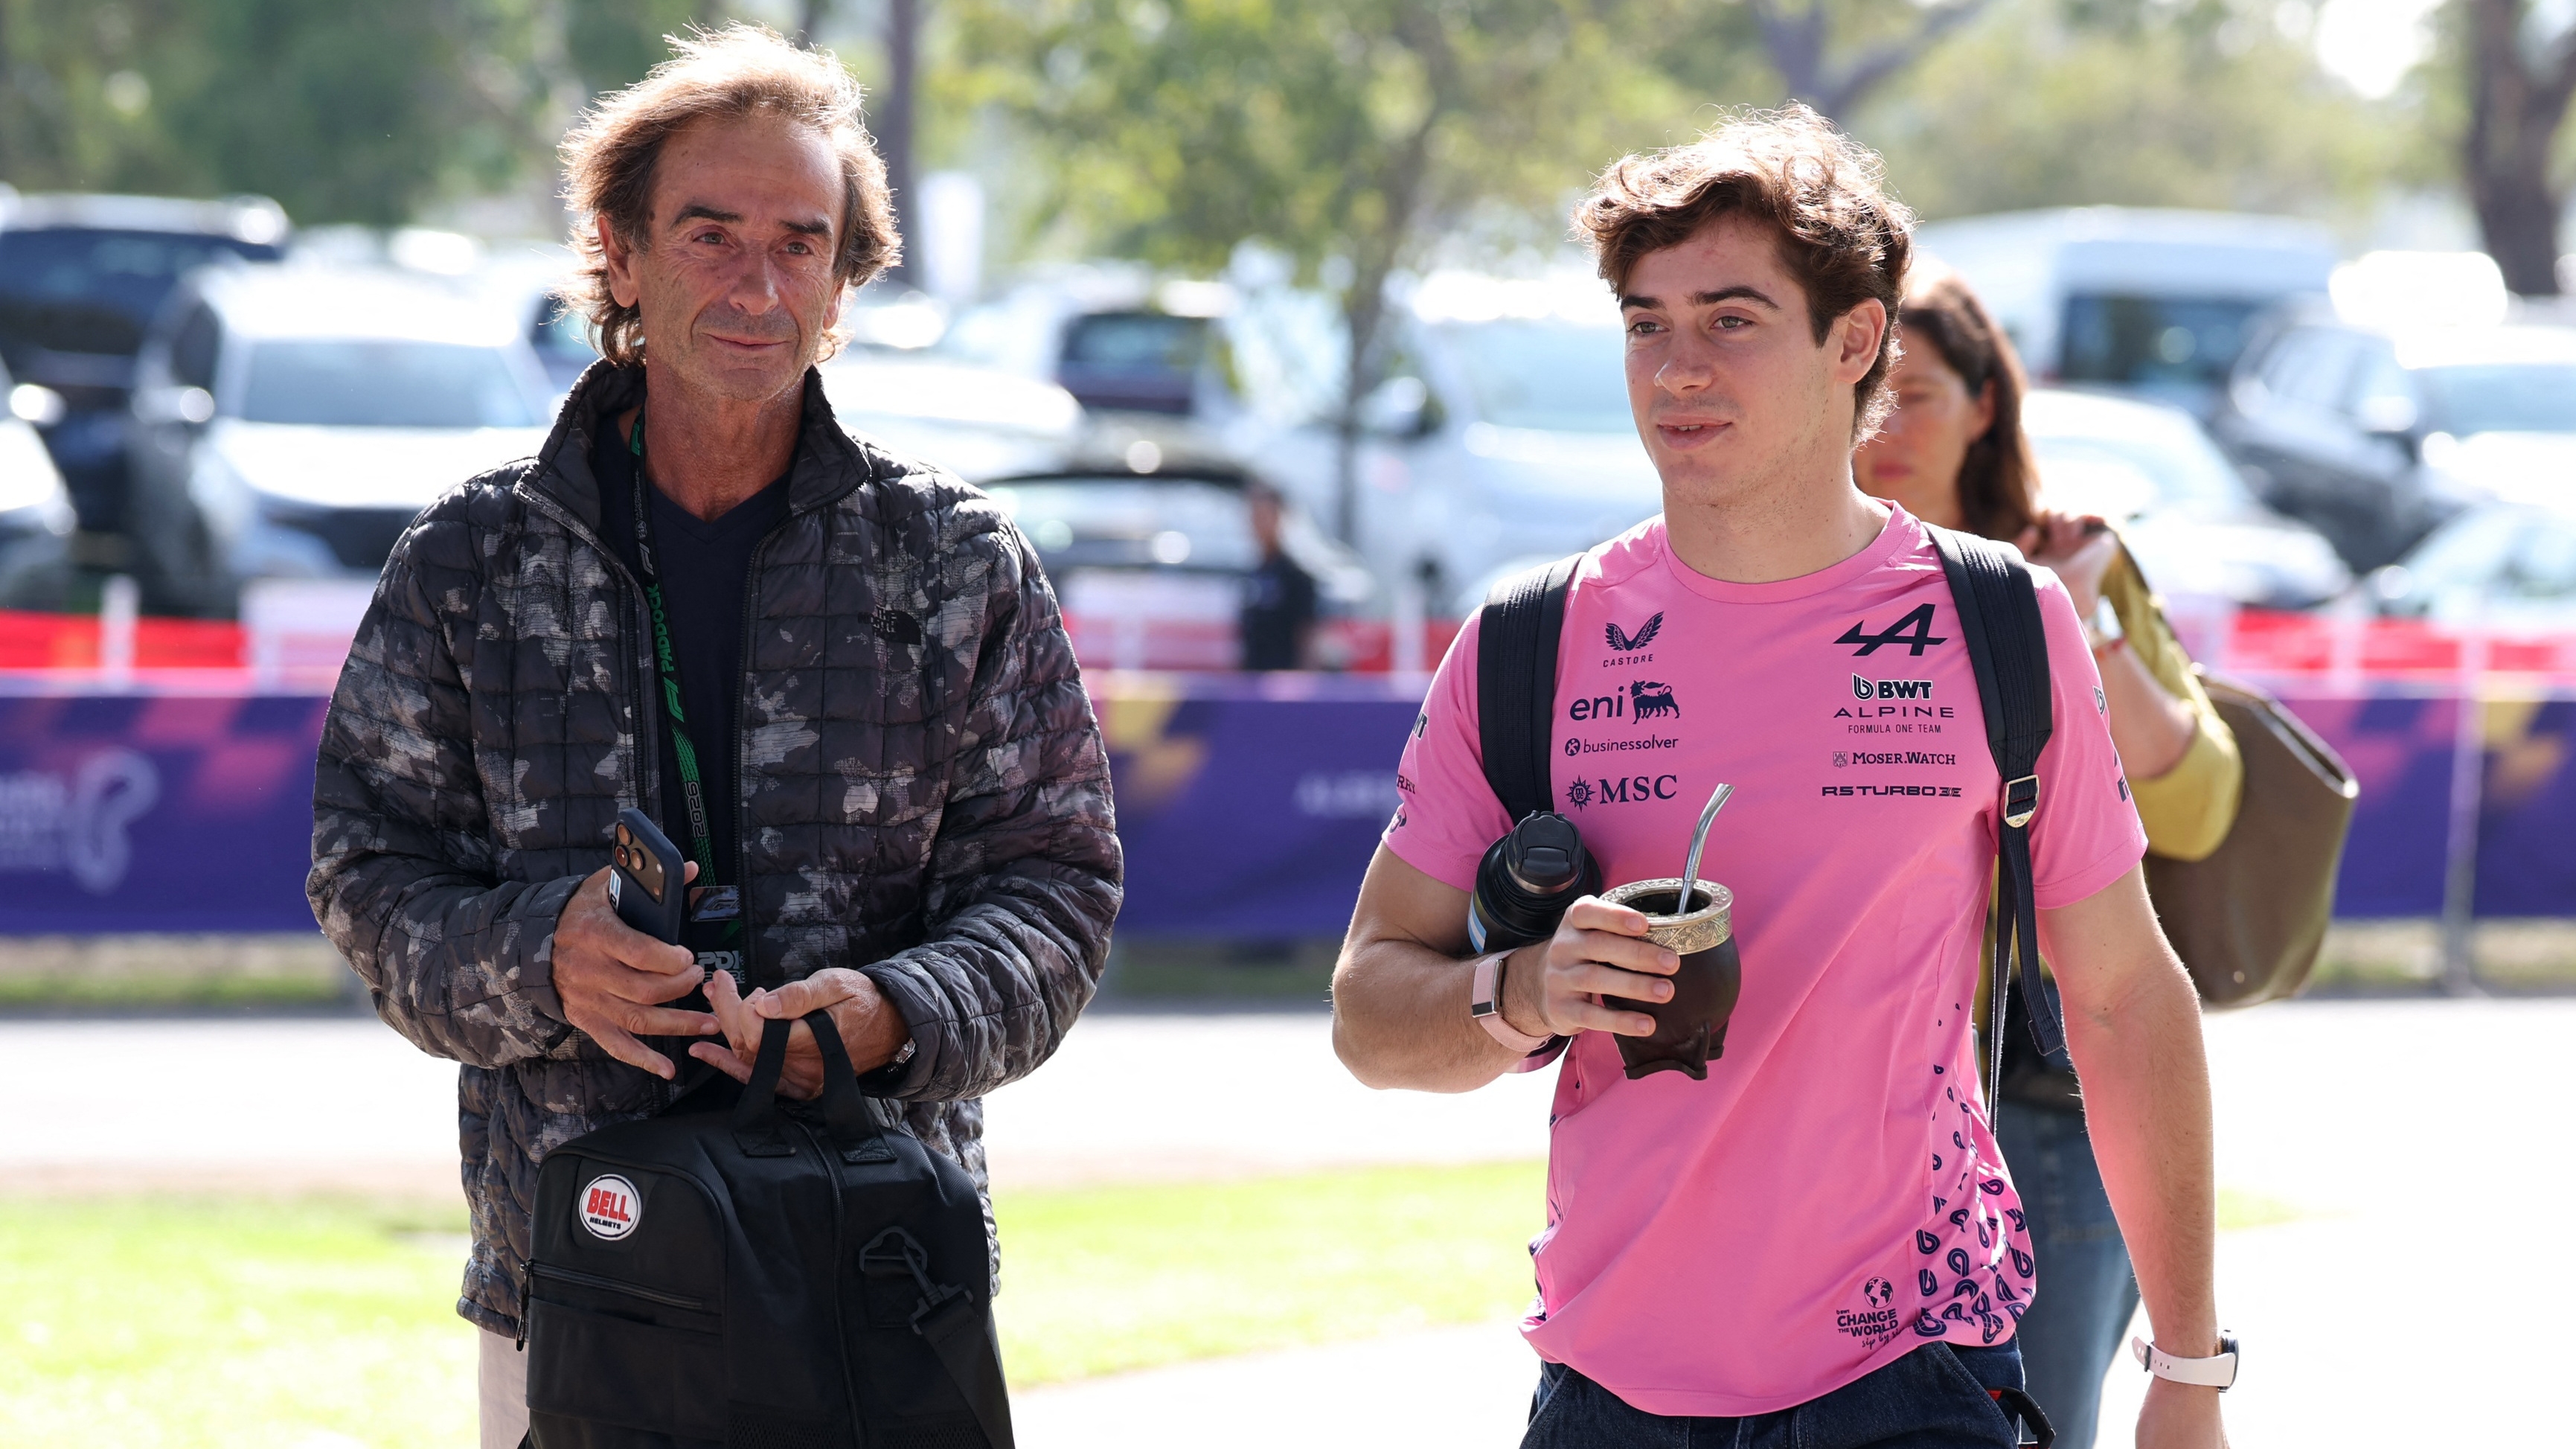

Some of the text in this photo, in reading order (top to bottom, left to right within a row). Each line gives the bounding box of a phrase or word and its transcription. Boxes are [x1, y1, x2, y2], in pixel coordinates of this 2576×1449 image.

[647, 583, 675, 673] PADDOCK
[1603, 653, 1654, 668] CASTORE
[1878, 681, 1932, 700] BWT
[1569, 686, 1624, 721] eni
[1833, 706, 1954, 718] ALPINE
[1848, 724, 1941, 734] FORMULA ONE TEAM
[1583, 735, 1679, 753] businessolver
[1598, 774, 1677, 805] MSC
[684, 781, 707, 838] 2026
[589, 1217, 621, 1229] HELMETS
[1837, 1308, 1897, 1327] CHANGE
[1851, 1320, 1898, 1337] WORLD
[1862, 1337, 1876, 1350] sip
[1879, 1329, 1889, 1346] by
